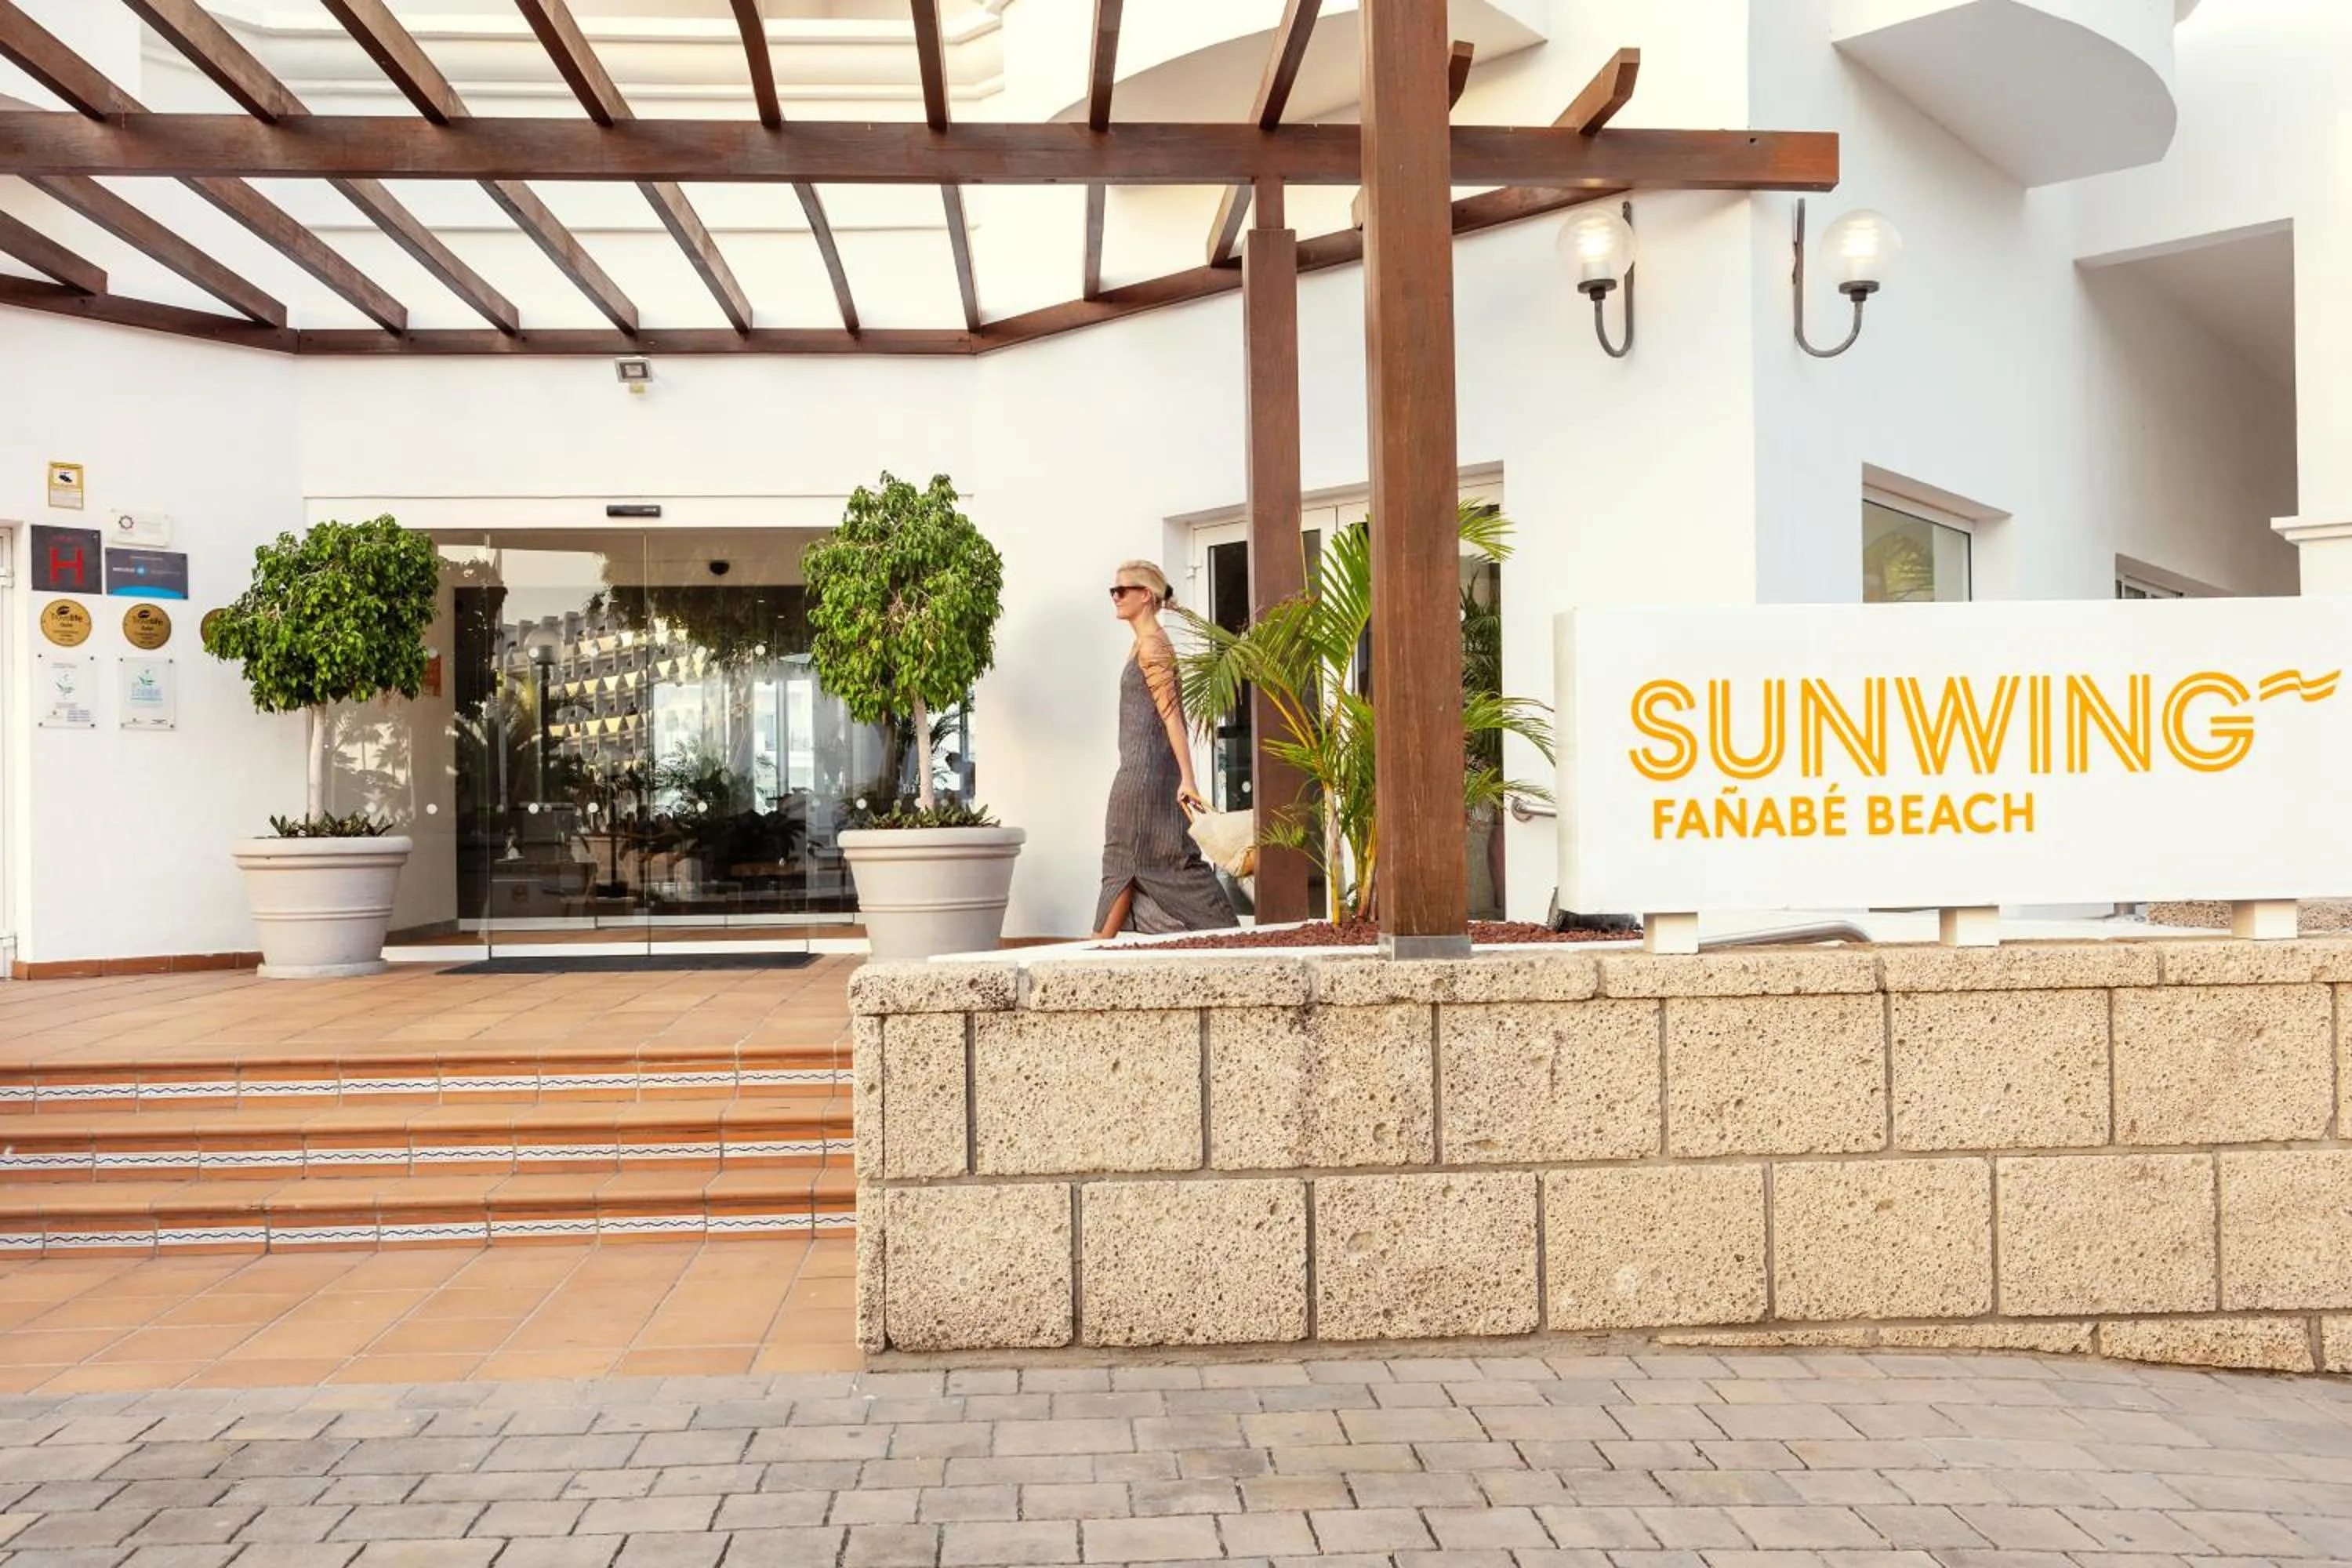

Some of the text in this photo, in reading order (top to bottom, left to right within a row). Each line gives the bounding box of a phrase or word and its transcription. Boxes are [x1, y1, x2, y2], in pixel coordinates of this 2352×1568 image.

[49, 546, 85, 586] H
[1629, 671, 2255, 781] SUNWING
[1653, 785, 2034, 839] FAÑABÉ BEACH
